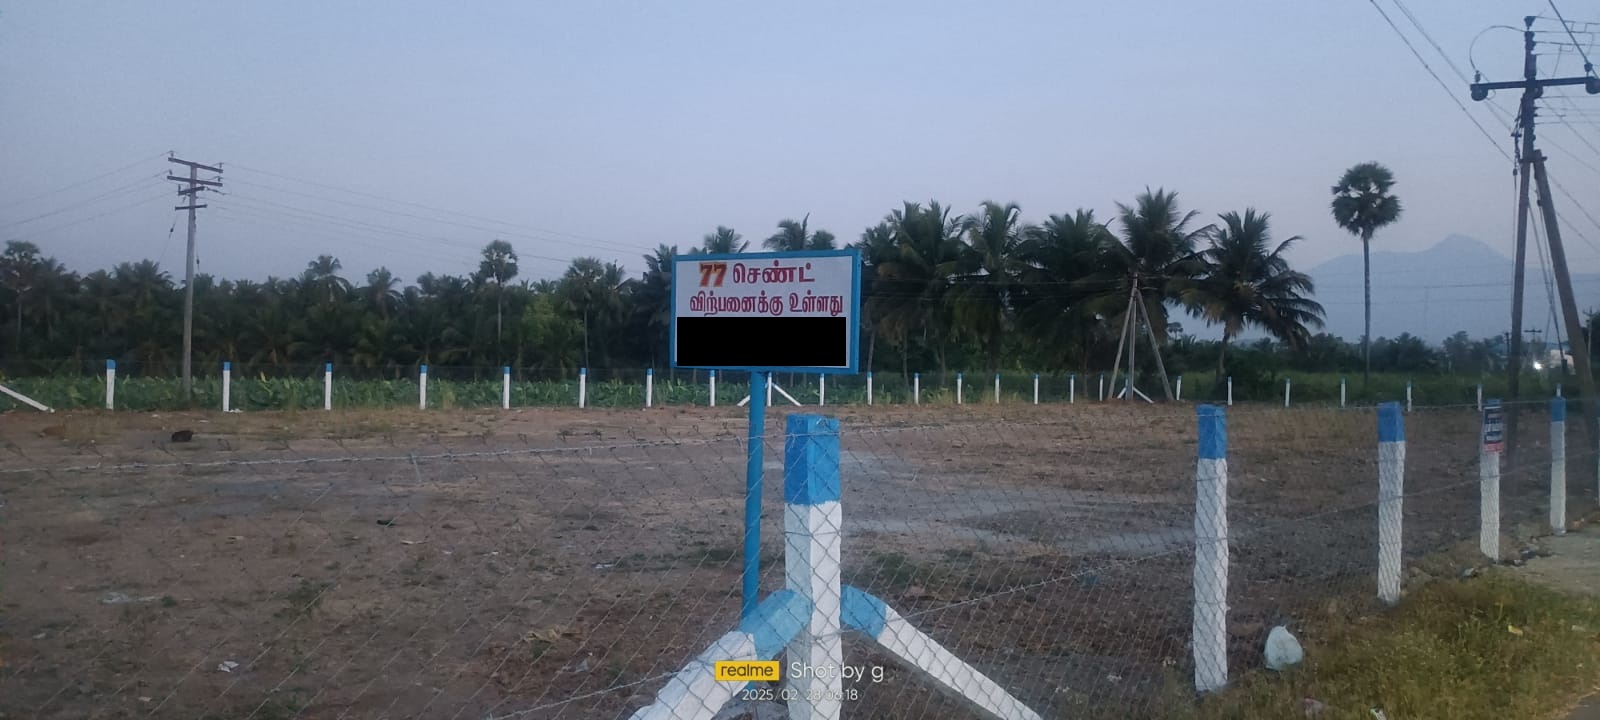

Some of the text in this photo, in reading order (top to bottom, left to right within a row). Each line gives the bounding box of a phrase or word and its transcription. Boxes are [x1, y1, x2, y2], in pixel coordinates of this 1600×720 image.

[699, 260, 815, 287] 77 செண்ட்
[690, 290, 843, 316] விற்பனைக்கு உள்ளது
